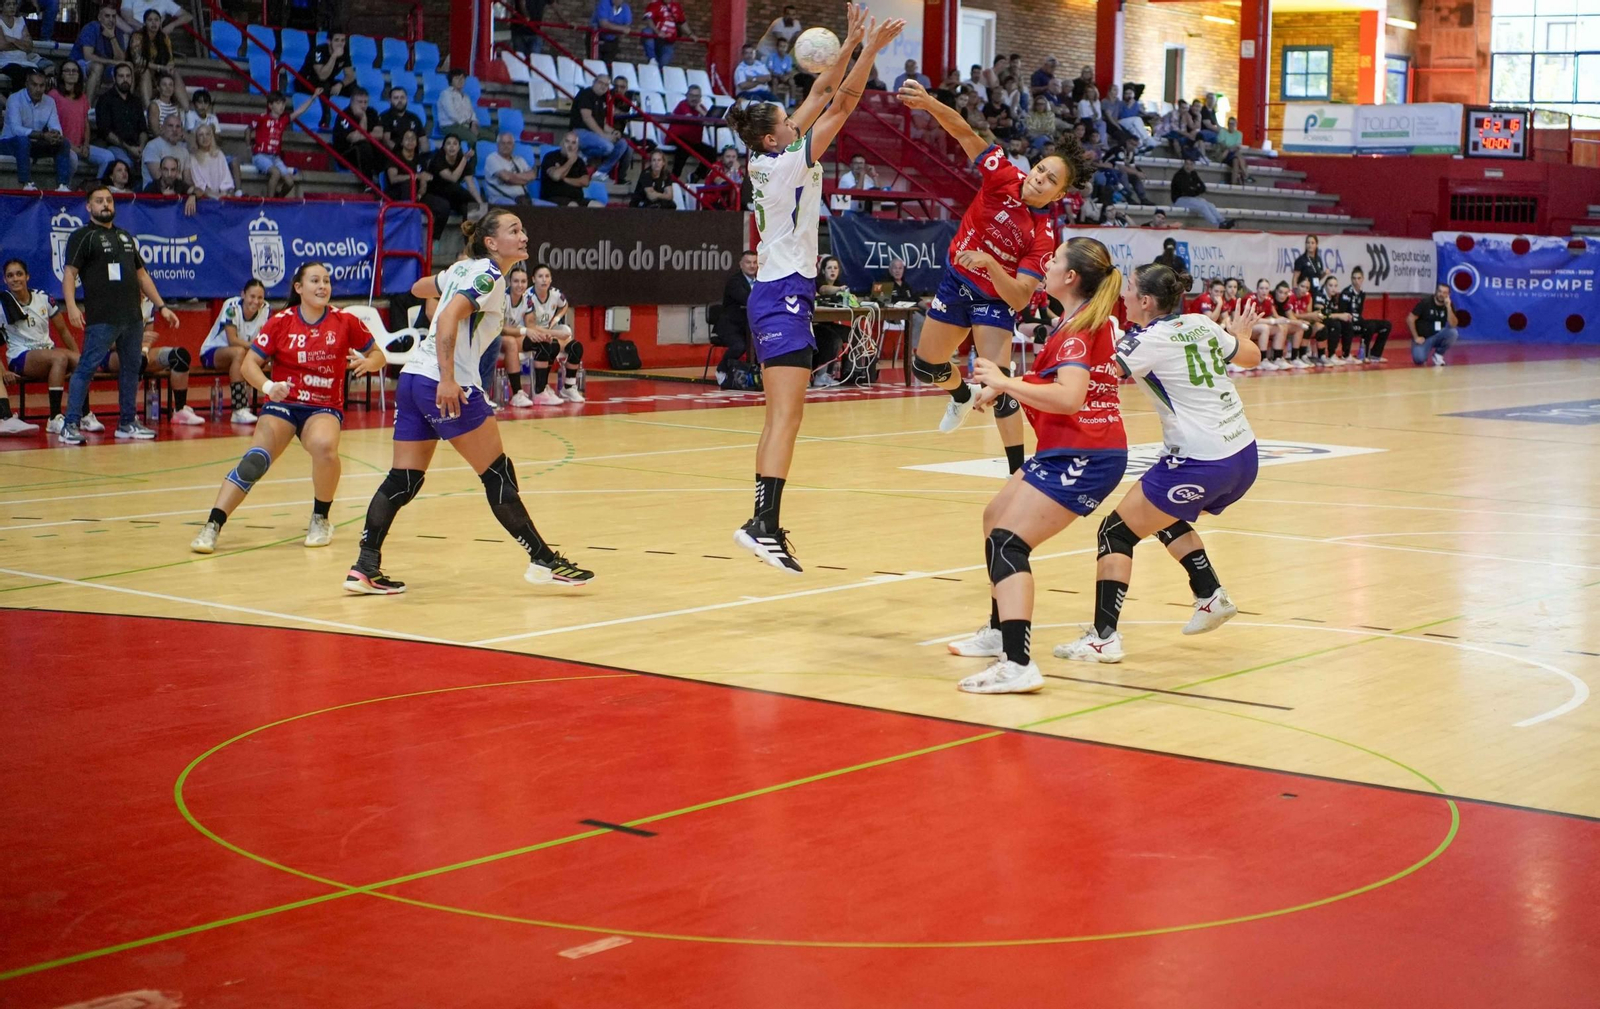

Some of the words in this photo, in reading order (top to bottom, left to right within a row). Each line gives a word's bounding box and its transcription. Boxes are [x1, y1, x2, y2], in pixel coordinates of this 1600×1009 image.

[1362, 116, 1410, 131] TOLDO
[1493, 121, 1501, 133] 2
[1482, 137, 1511, 150] 40:04
[291, 237, 369, 257] Concello
[863, 240, 942, 269] ZENDAL
[1192, 246, 1226, 260] XUNTA
[538, 239, 624, 271] Concello
[628, 240, 655, 271] do
[659, 243, 733, 271] Porriño
[1391, 249, 1432, 264] Deputación
[1193, 264, 1206, 280] DE
[1208, 265, 1244, 281] GALICIA
[1484, 276, 1594, 292] IBERPOMPE
[288, 333, 307, 349] 78
[1184, 336, 1226, 388] 44
[1078, 416, 1107, 424] Xacobeo
[1175, 488, 1204, 502] CSIF
